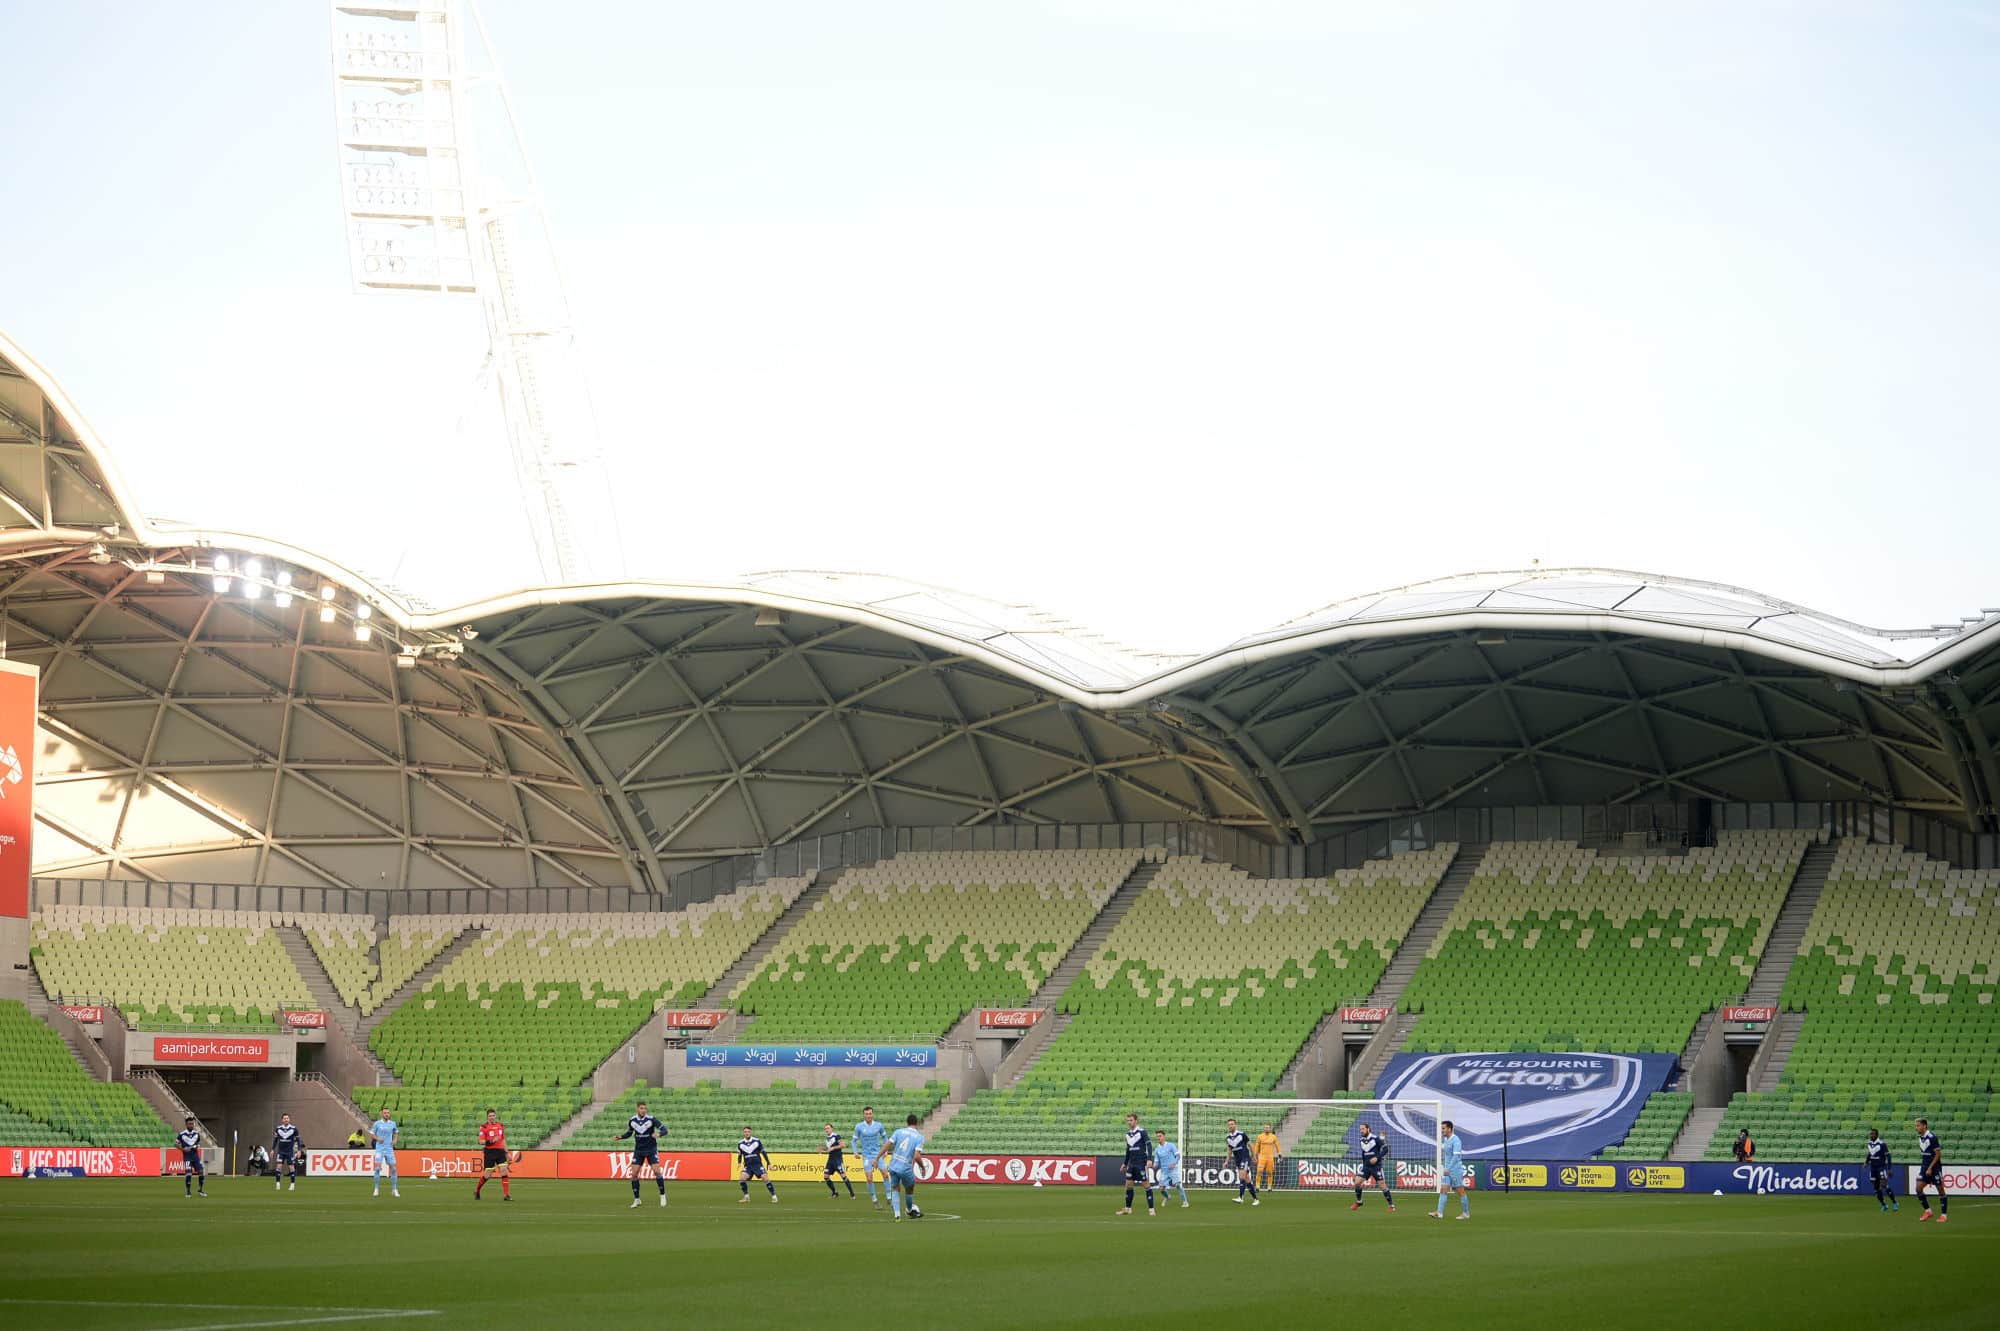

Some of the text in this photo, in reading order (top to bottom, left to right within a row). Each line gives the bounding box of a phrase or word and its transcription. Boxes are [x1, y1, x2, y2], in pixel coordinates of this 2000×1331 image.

[161, 1042, 262, 1057] aamipark.com.au
[710, 1051, 728, 1065] agl
[759, 1051, 777, 1065] agl
[809, 1051, 827, 1065] agl
[859, 1051, 878, 1065] agl
[910, 1051, 928, 1065] agl
[1457, 1060, 1603, 1068] MELBOURNE
[1447, 1068, 1604, 1088] Victory
[900, 1136, 909, 1152] 4
[29, 1150, 113, 1174] KFC DELIVERS
[421, 1157, 512, 1177] DelphiB
[935, 1159, 997, 1180] KFC
[1298, 1160, 1365, 1175] BUNNING
[1028, 1160, 1093, 1181] KFC
[1304, 1175, 1371, 1186] warehoue
[1403, 1175, 1471, 1187] waree
[1733, 1165, 1858, 1192] Mirabella
